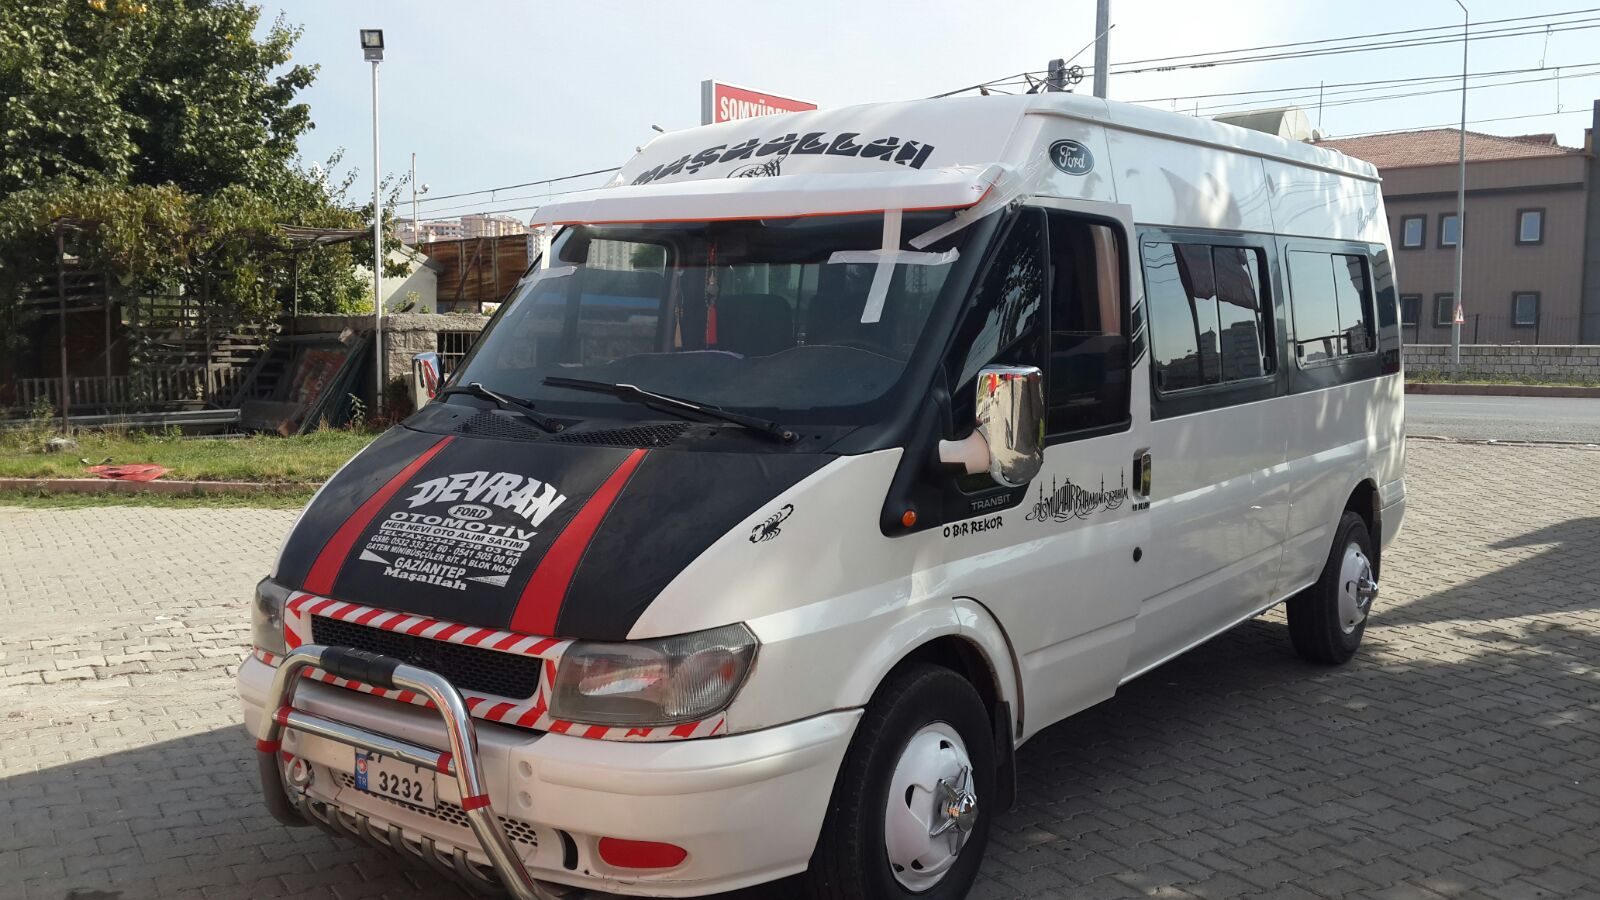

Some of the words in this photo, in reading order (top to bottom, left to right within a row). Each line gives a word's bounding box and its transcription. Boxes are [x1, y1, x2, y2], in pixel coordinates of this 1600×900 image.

[720, 96, 791, 120] SOMYÜR
[405, 471, 567, 527] DEVRAN
[971, 494, 1011, 511] TRANSIT
[390, 511, 538, 540] OTOMOTİV
[453, 506, 487, 519] FORD
[384, 521, 405, 529] HER
[433, 528, 455, 537] OTO
[457, 532, 486, 542] ALIM
[487, 536, 524, 549] SATIM
[943, 527, 951, 538] O
[971, 516, 1003, 535] REKOR
[366, 542, 390, 552] GATEM
[460, 558, 468, 566] A
[467, 559, 492, 571] BLOK
[370, 534, 390, 544] GSM:
[390, 537, 410, 547] 0532
[424, 543, 438, 551] 27
[436, 544, 449, 553] 60
[453, 547, 475, 558] 0541
[475, 551, 493, 561] 505
[492, 554, 506, 564] 00
[505, 557, 519, 567] 60
[383, 566, 467, 591] Maşallah
[394, 556, 467, 579] GAZİANTEP
[379, 771, 424, 802] 3232
